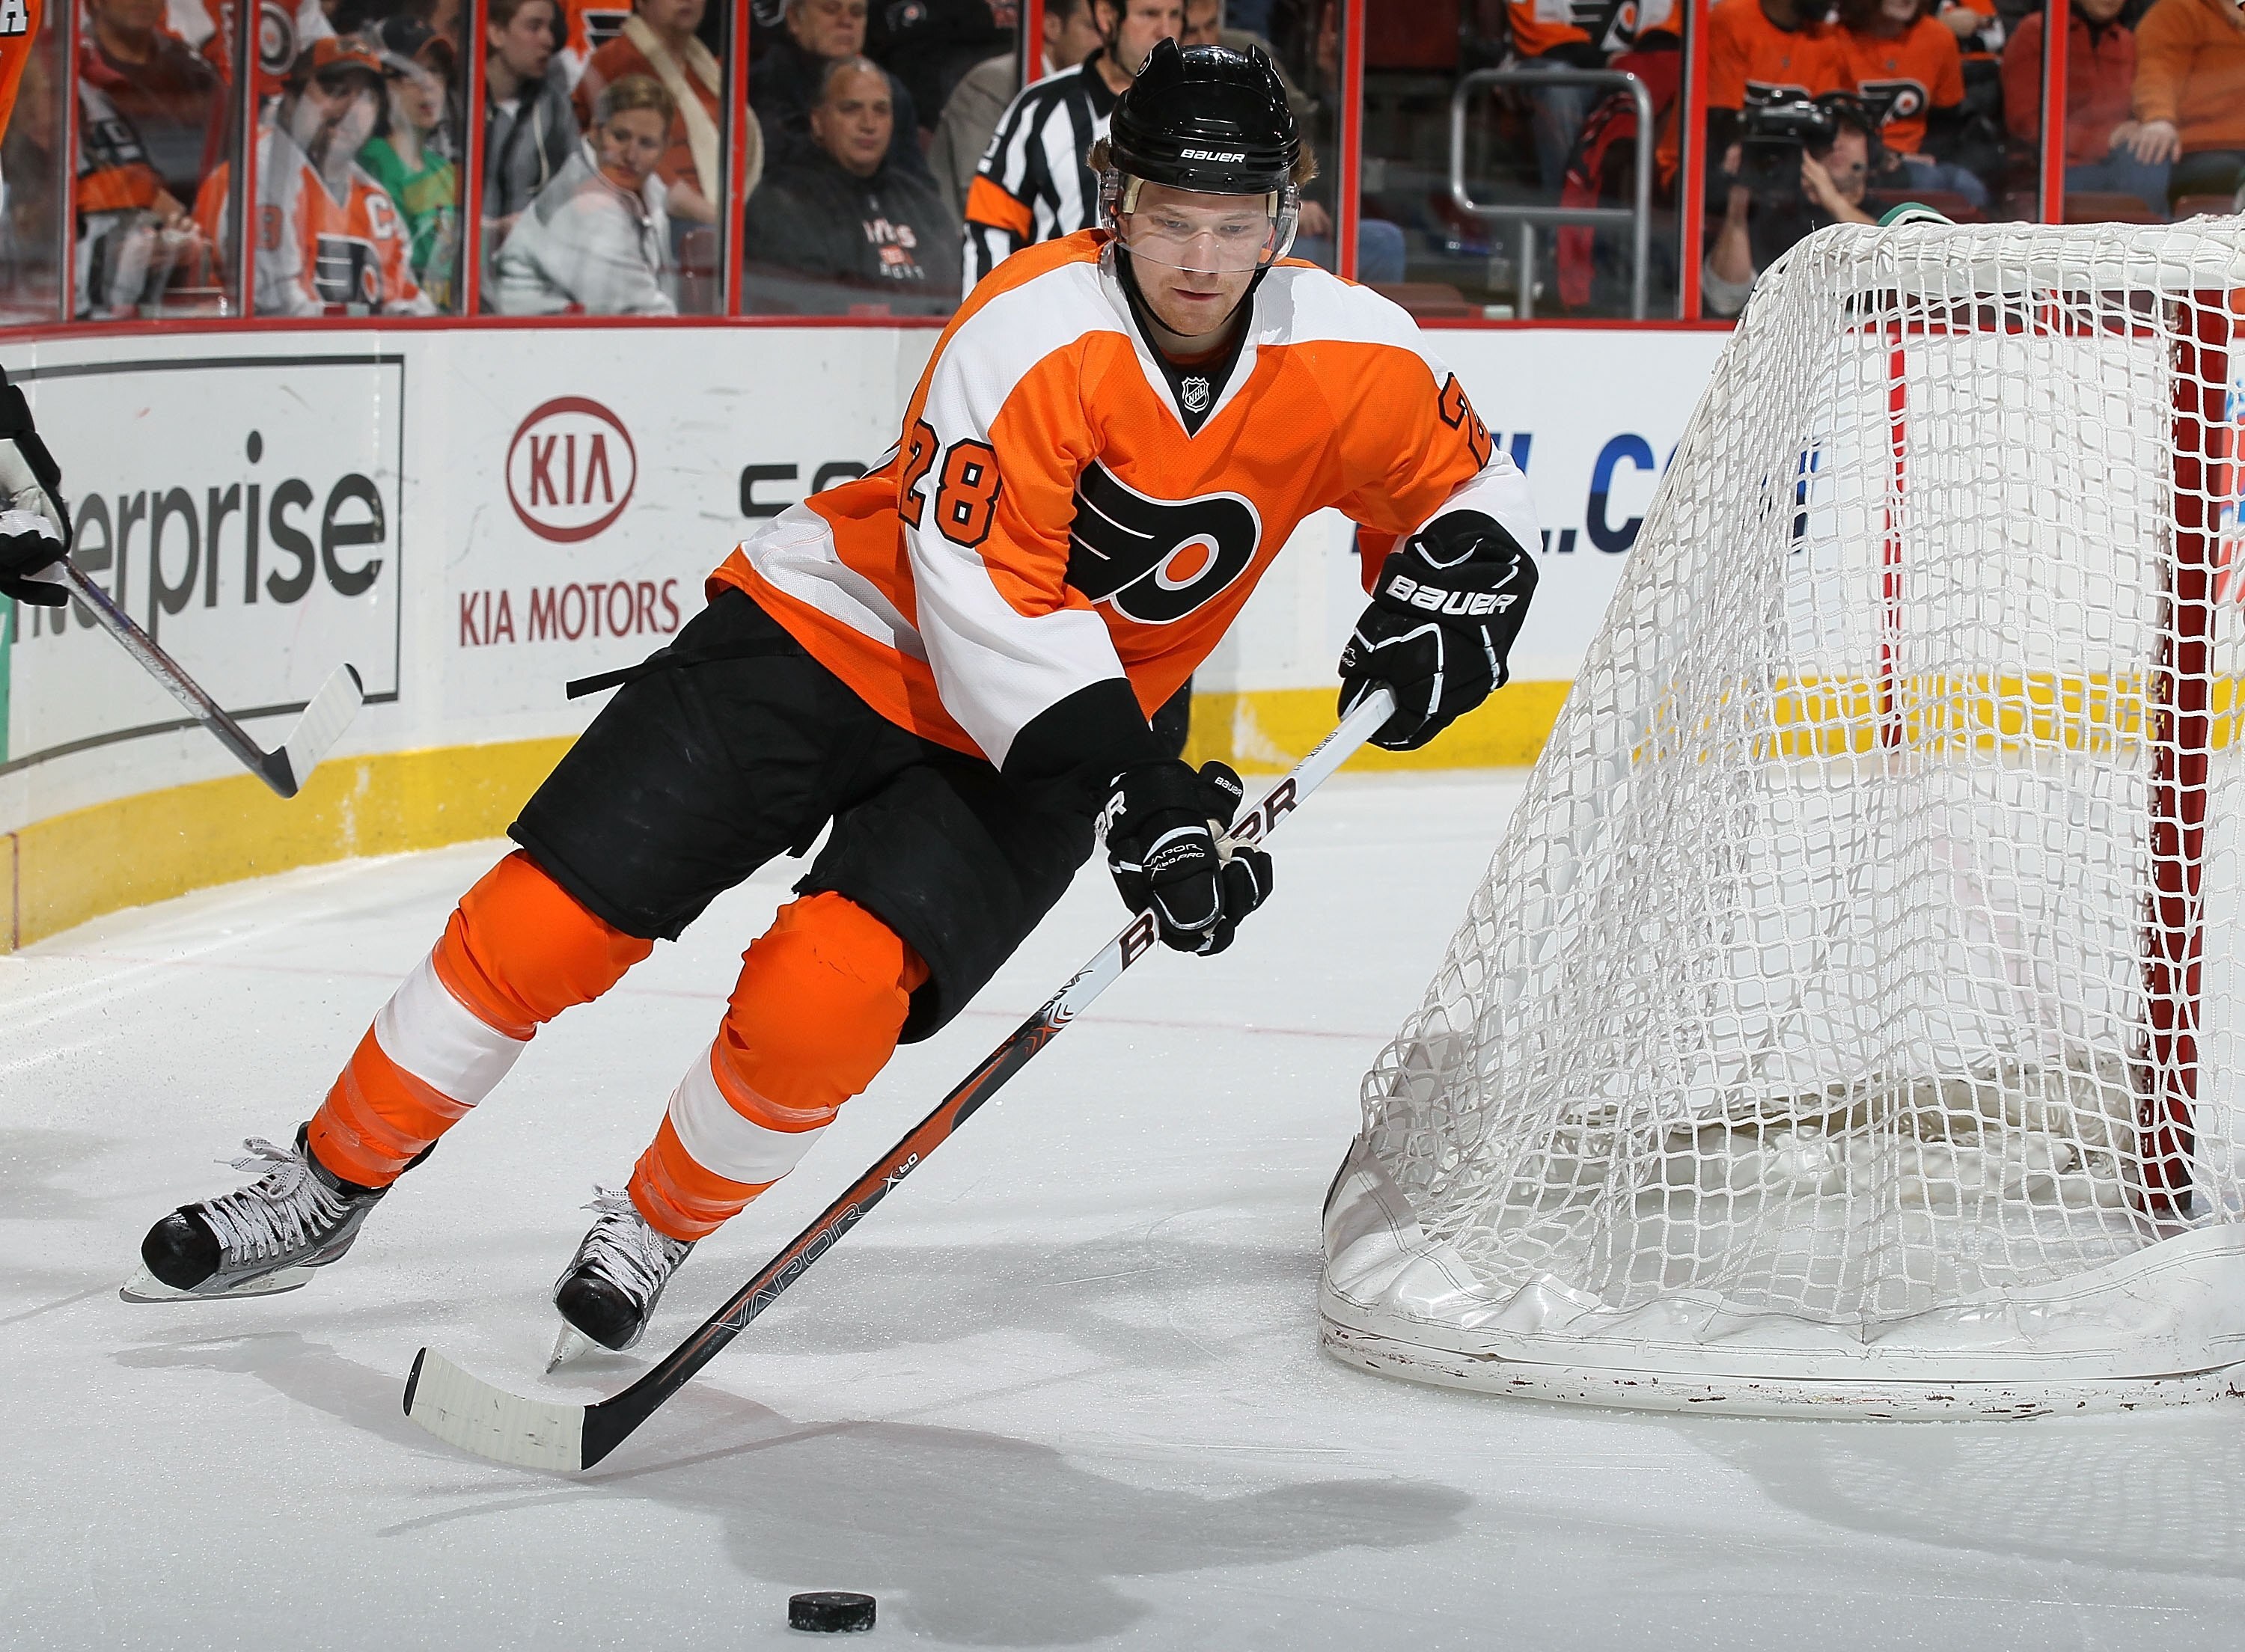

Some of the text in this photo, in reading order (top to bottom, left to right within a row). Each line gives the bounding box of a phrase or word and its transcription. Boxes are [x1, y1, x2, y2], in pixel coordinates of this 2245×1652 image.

[1180, 148, 1245, 163] BAUER
[1188, 386, 1205, 404] NHL
[529, 433, 614, 507] KIA
[897, 417, 1004, 549] 28
[12, 429, 386, 643] erprise
[460, 578, 680, 648] KIA MOTORS
[1386, 575, 1518, 616] BAUER
[1214, 776, 1243, 798] BAUER
[1143, 843, 1203, 868] VAPOR
[1176, 852, 1206, 862] PRO
[711, 1202, 868, 1333] VAPOR
